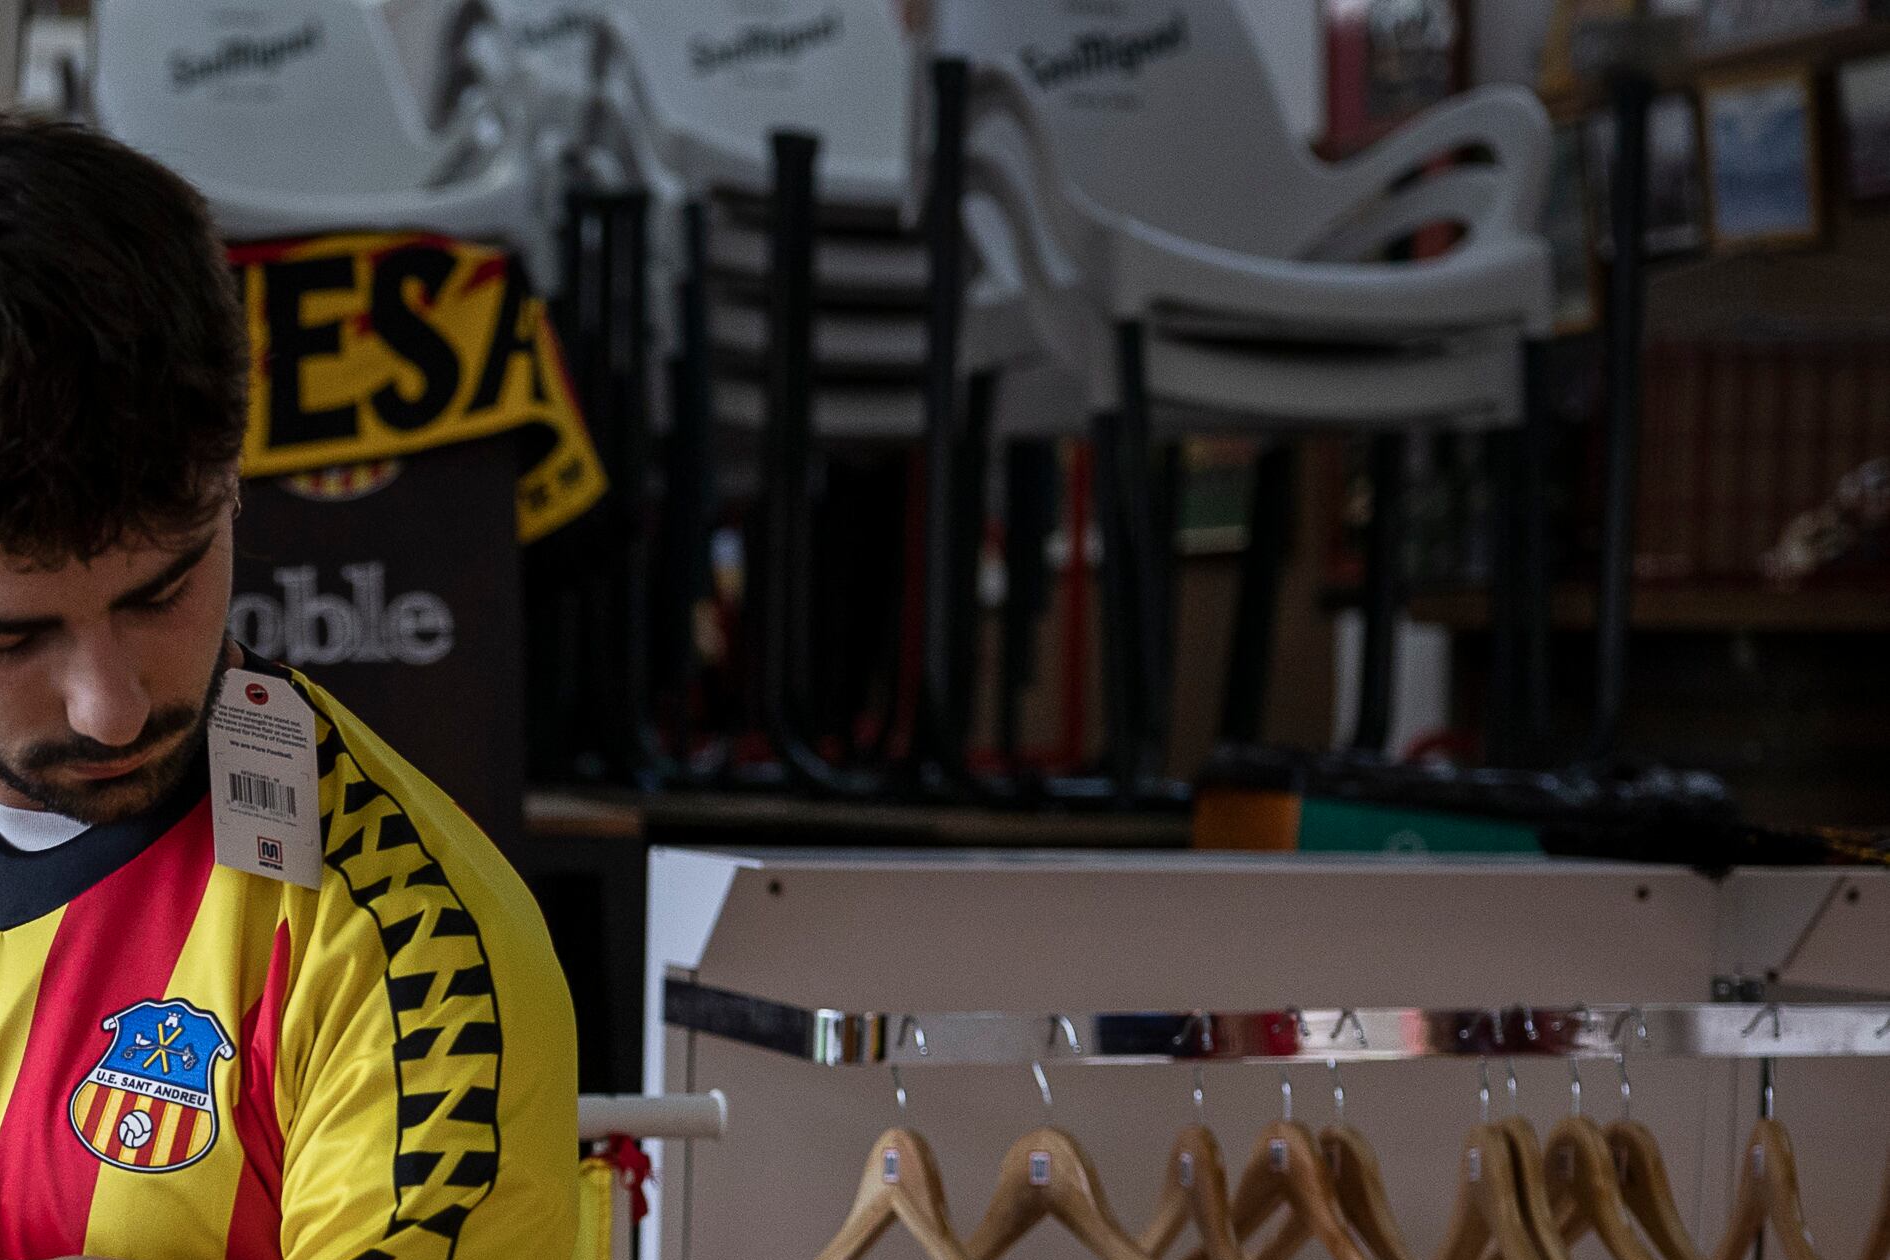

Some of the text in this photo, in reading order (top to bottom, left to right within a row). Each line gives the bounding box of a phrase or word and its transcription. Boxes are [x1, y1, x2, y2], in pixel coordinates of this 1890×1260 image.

[227, 562, 456, 666] oble
[96, 1070, 207, 1106] U.E. SANT ANDREU
